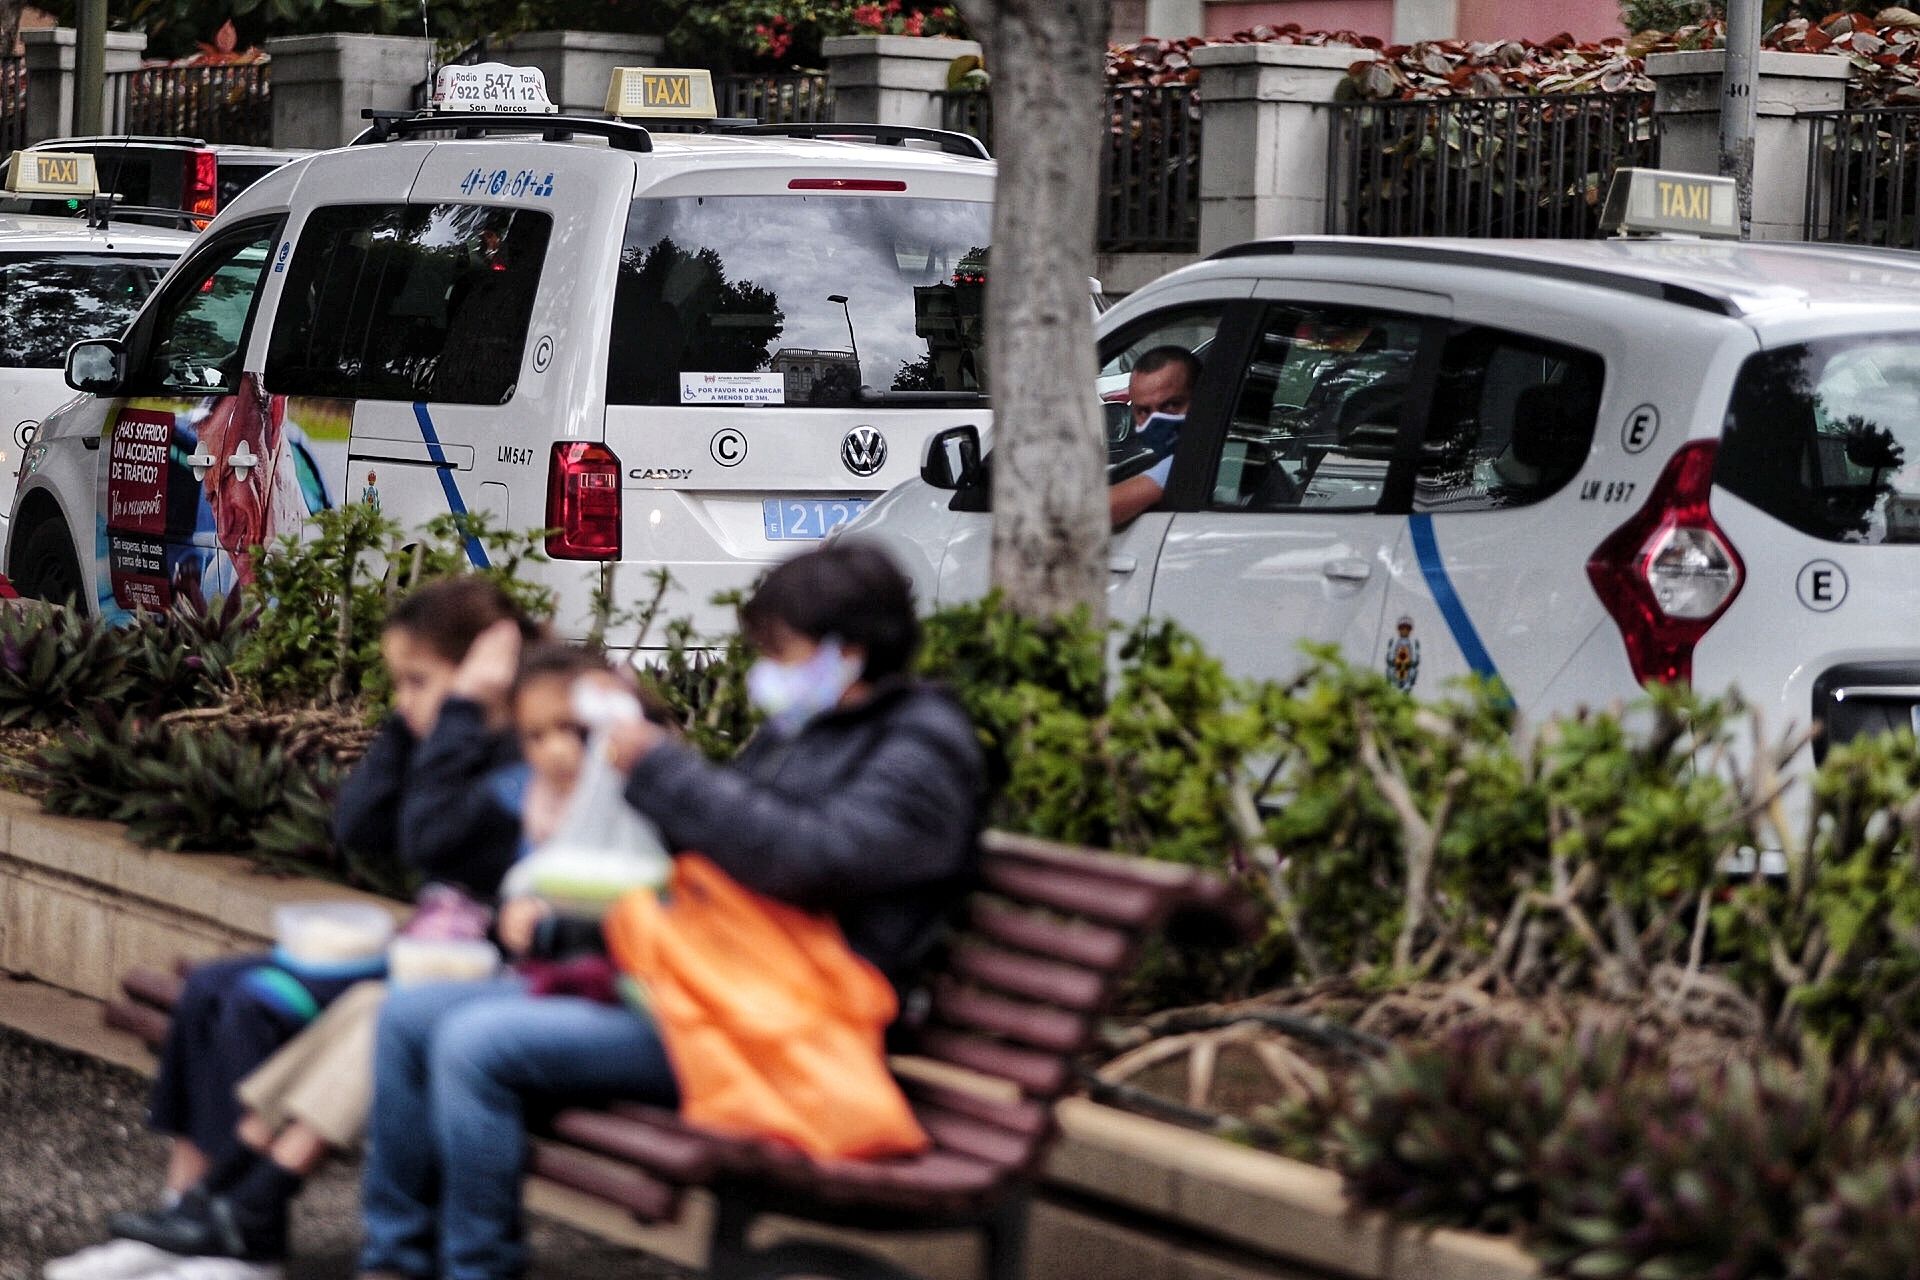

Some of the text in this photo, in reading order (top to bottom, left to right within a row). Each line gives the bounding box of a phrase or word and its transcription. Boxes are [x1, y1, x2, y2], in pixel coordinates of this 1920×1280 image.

[456, 73, 478, 82] Radio
[485, 74, 514, 89] 547
[520, 74, 536, 84] Taxi
[643, 77, 690, 105] TAXI
[457, 86, 480, 100] 922
[483, 87, 499, 100] 64
[502, 87, 516, 100] 11
[521, 87, 535, 101] 12
[469, 104, 528, 113] San Marcos
[38, 158, 77, 182] TAXI
[1658, 182, 1709, 220] TAXI
[114, 421, 168, 443] ¿HAS SUFRIDO
[113, 441, 167, 464] UN ACCIDENTE
[497, 445, 534, 466] LM547
[112, 460, 159, 484] DE TRÁFICO?
[629, 468, 693, 480] CADDY
[789, 502, 866, 535] 212
[113, 536, 163, 556] Sin esperas, sin coste
[121, 556, 135, 567] cerca
[134, 554, 142, 568] de
[142, 557, 148, 569] tu
[148, 560, 160, 571] casa
